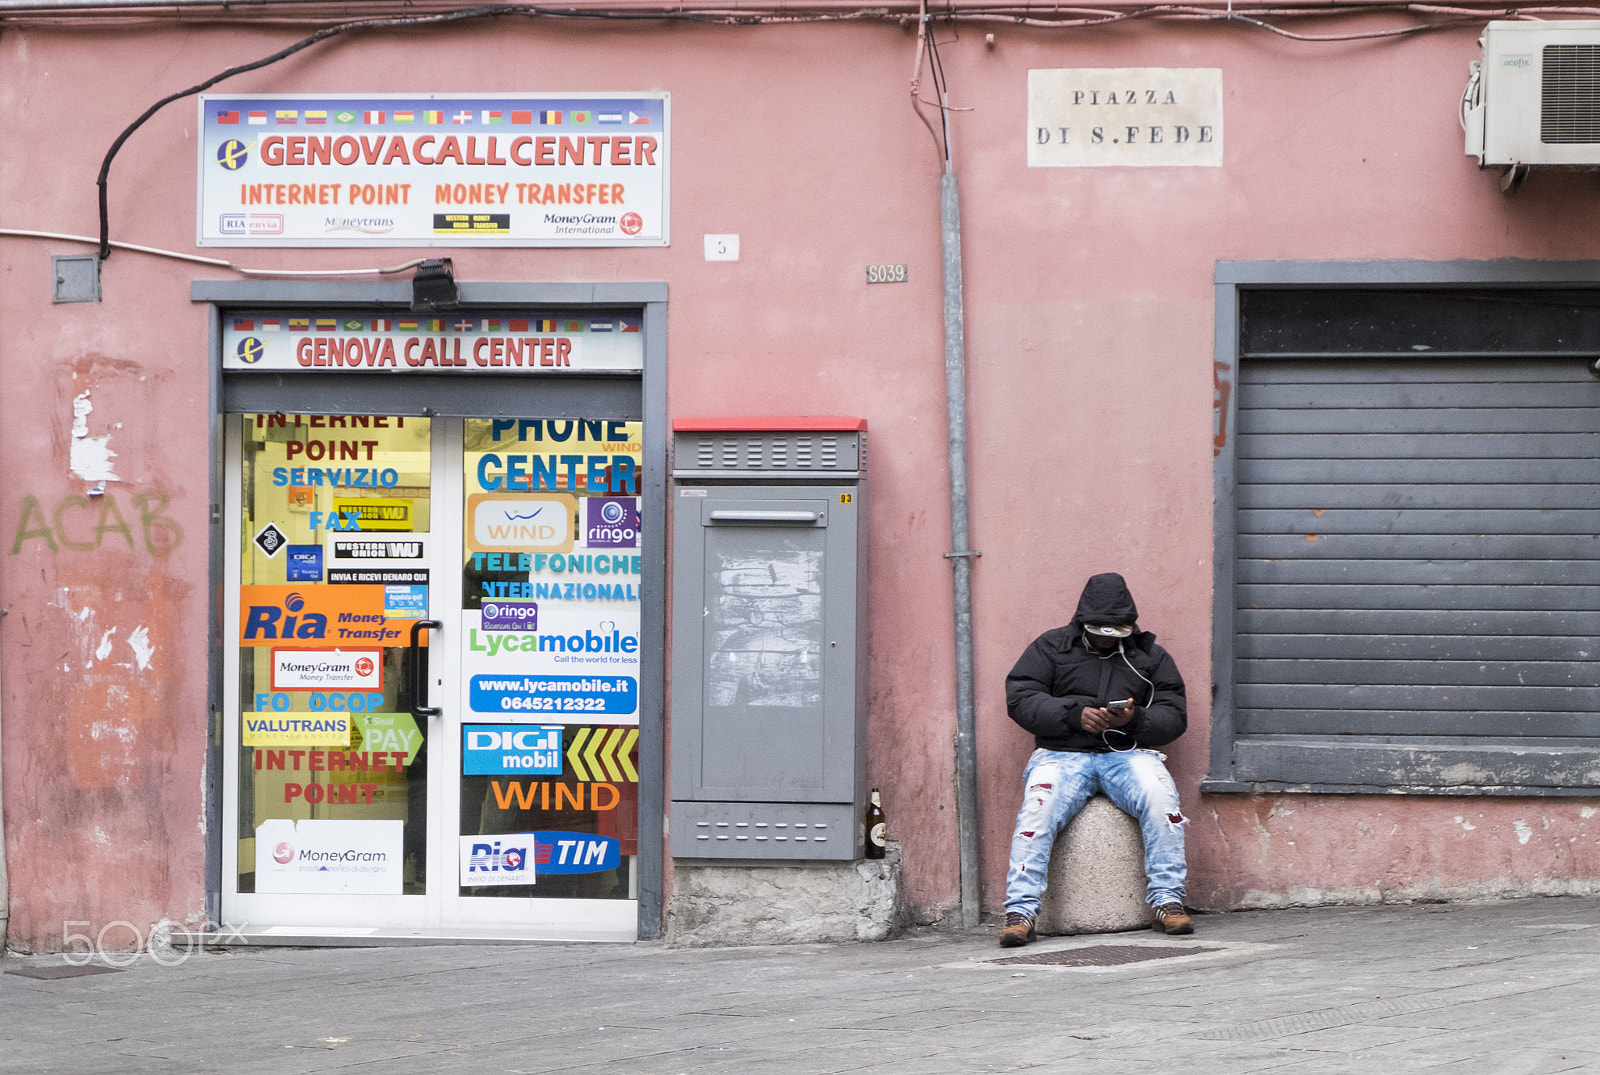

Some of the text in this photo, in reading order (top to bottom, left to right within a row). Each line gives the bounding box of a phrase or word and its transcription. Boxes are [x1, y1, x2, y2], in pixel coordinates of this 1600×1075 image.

[1072, 90, 1177, 105] PIAZZA
[1035, 127, 1070, 144] DI
[510, 135, 657, 166] CENTER
[241, 183, 625, 205] INTERNET POINT MONEY TRANSFER
[227, 219, 245, 228] RIA
[325, 217, 394, 228] Mneytrans
[544, 213, 616, 225] MoneyGram
[555, 226, 614, 234] International
[868, 264, 905, 282] S039
[296, 337, 571, 367] GENOVA CALL CENTER
[256, 414, 405, 428] INTERNET
[492, 419, 629, 442] PHONE
[286, 441, 379, 461] POINT
[602, 443, 642, 452] WIND
[272, 467, 399, 488] SERVIZIO
[477, 453, 636, 492] CENTER
[841, 493, 852, 503] 93
[11, 493, 185, 555] ACAB
[310, 511, 362, 531] FAX
[487, 525, 555, 540] WIND
[589, 525, 634, 543] ringo
[390, 543, 419, 557] WU
[471, 553, 641, 574] TELEFONICHE
[331, 573, 427, 581] INVIA E RICEVI DENARO QUI
[243, 592, 328, 640] Ria
[338, 612, 387, 626] Money
[500, 605, 536, 619] ringo
[338, 628, 401, 641] Transfer
[470, 628, 638, 656] Lycamobile
[280, 662, 350, 674] MoneyGram
[621, 656, 638, 664] less
[299, 673, 354, 682] Money Transfer
[479, 678, 629, 693] www.lycamobile.it
[501, 697, 606, 711] 0645212322
[247, 719, 347, 732] VALUTRANS
[366, 728, 416, 751] PAY
[467, 730, 558, 750] DIGI
[255, 750, 409, 772] INTERNET
[502, 751, 558, 768] mobil
[284, 783, 378, 804] POINT
[491, 781, 621, 811] WIND
[299, 850, 386, 862] MoneyGram
[469, 841, 527, 872] Ria
[557, 840, 608, 865] TIM
